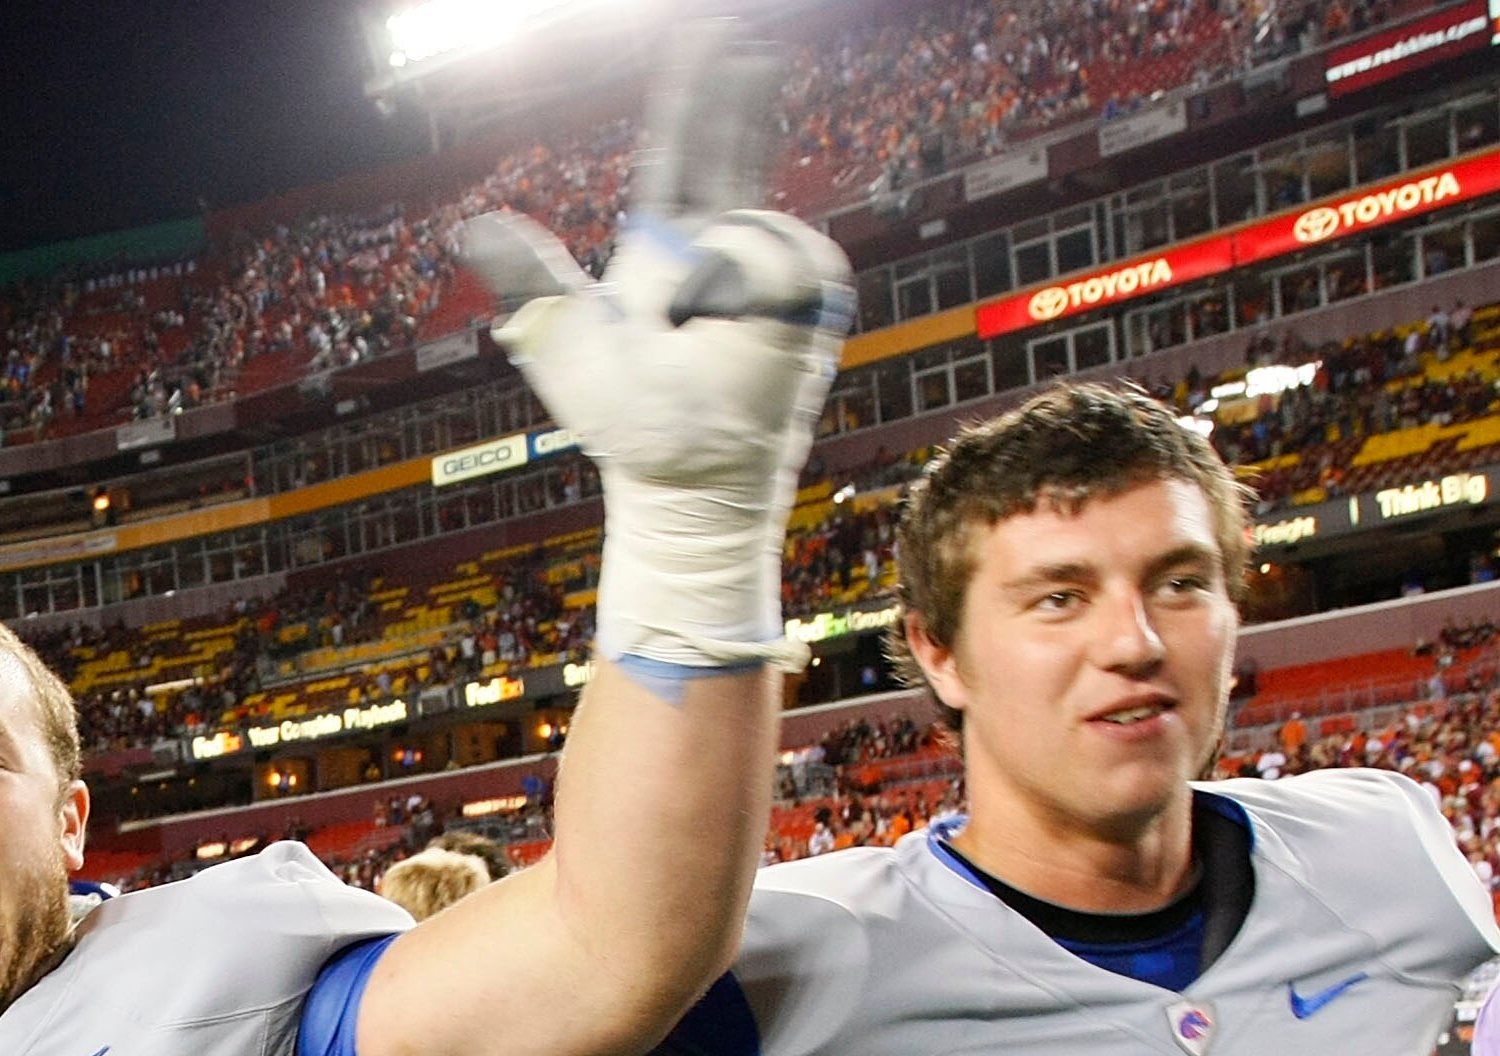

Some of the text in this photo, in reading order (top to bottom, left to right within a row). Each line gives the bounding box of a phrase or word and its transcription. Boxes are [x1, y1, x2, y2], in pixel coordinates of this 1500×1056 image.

[1325, 15, 1488, 82] www.redskins.com
[1341, 171, 1460, 229] TOYOTA
[1069, 258, 1172, 307] TOYOTA
[443, 445, 512, 477] GEICO
[1376, 480, 1441, 519] Think
[1441, 473, 1489, 505] Big
[465, 676, 523, 706] FedEx
[192, 732, 242, 758] FedEx
